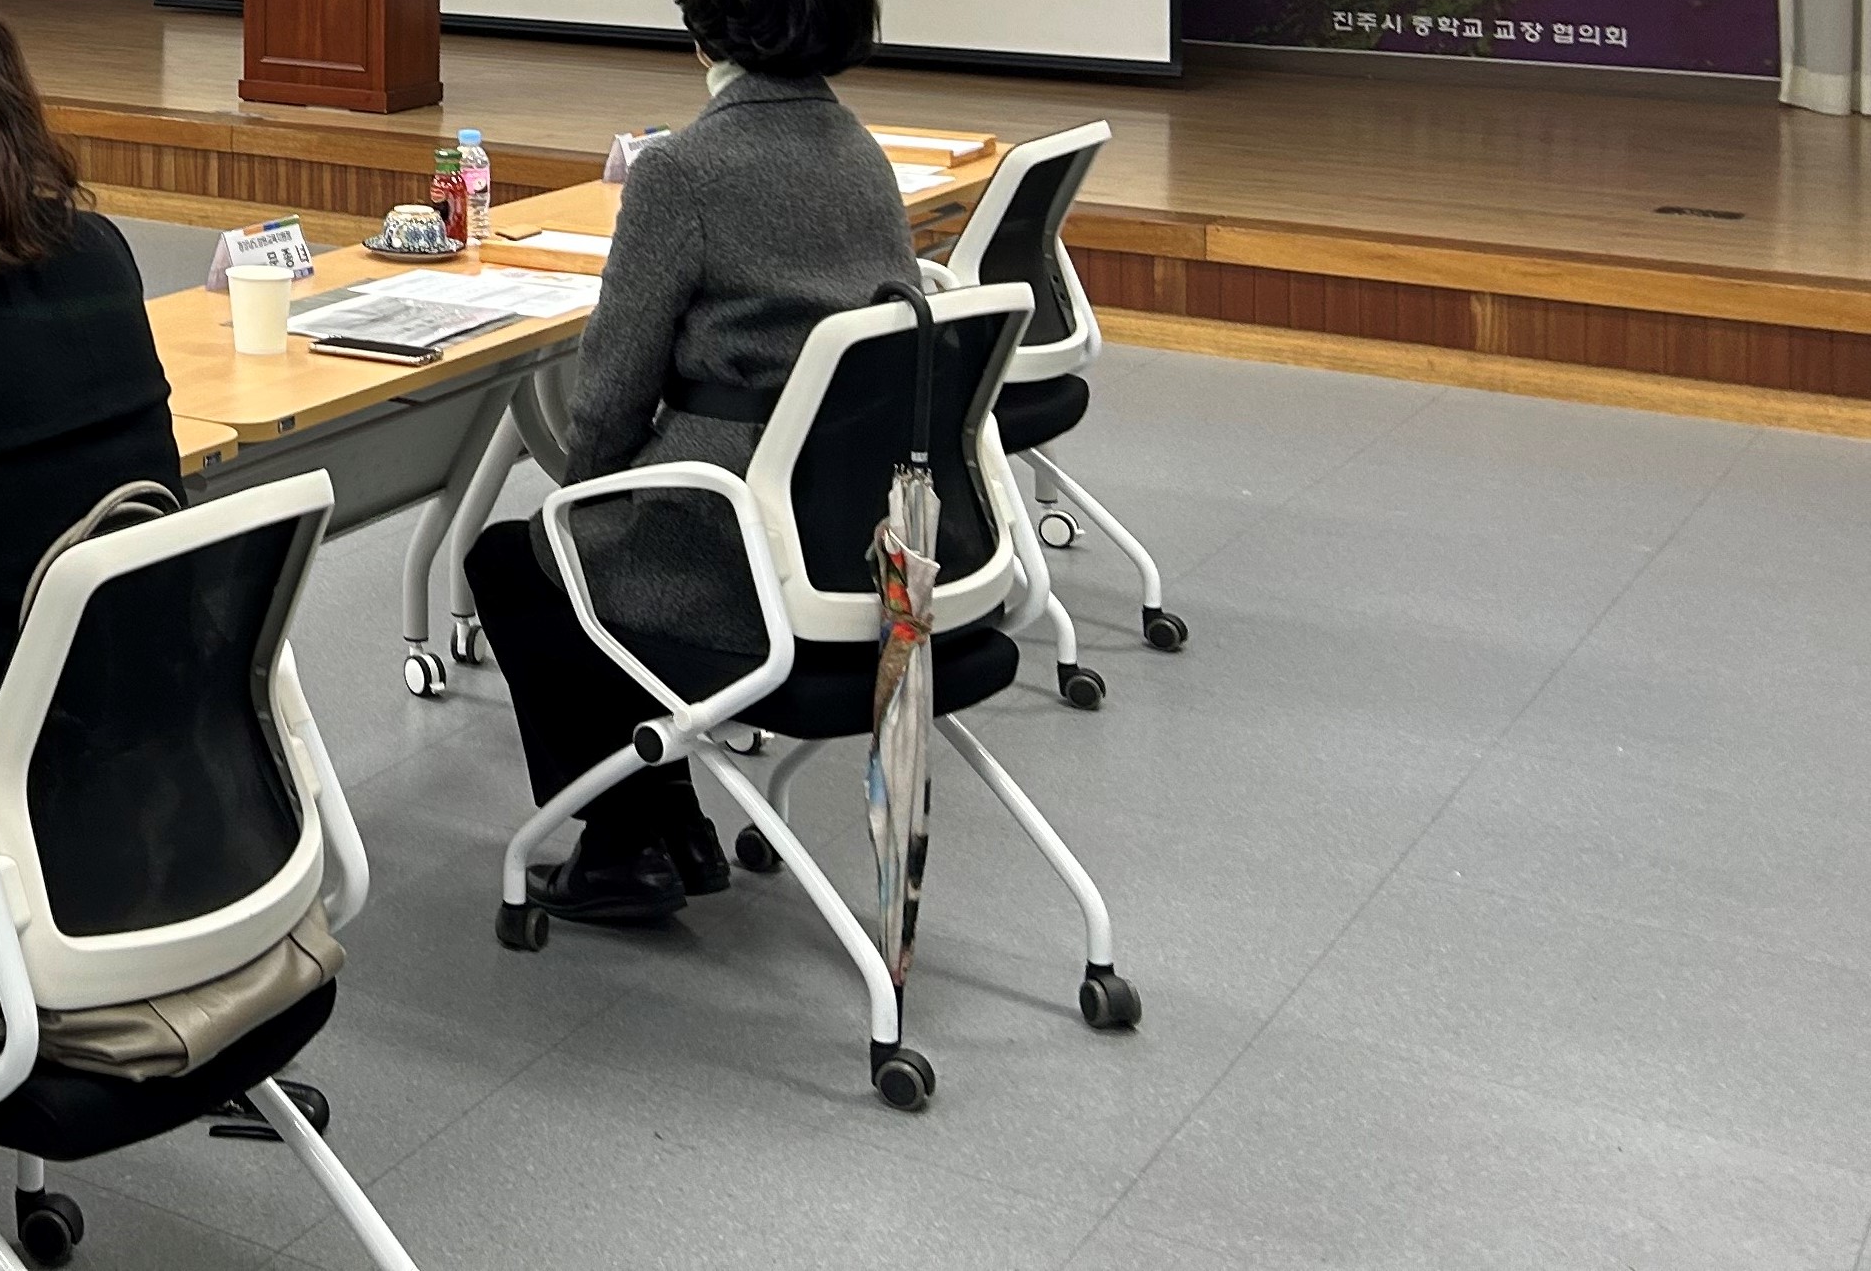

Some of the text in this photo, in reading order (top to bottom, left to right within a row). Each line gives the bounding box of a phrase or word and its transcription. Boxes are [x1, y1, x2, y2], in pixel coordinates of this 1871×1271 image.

[1332, 10, 1628, 48] 진주시 중학교 교장 협의회
